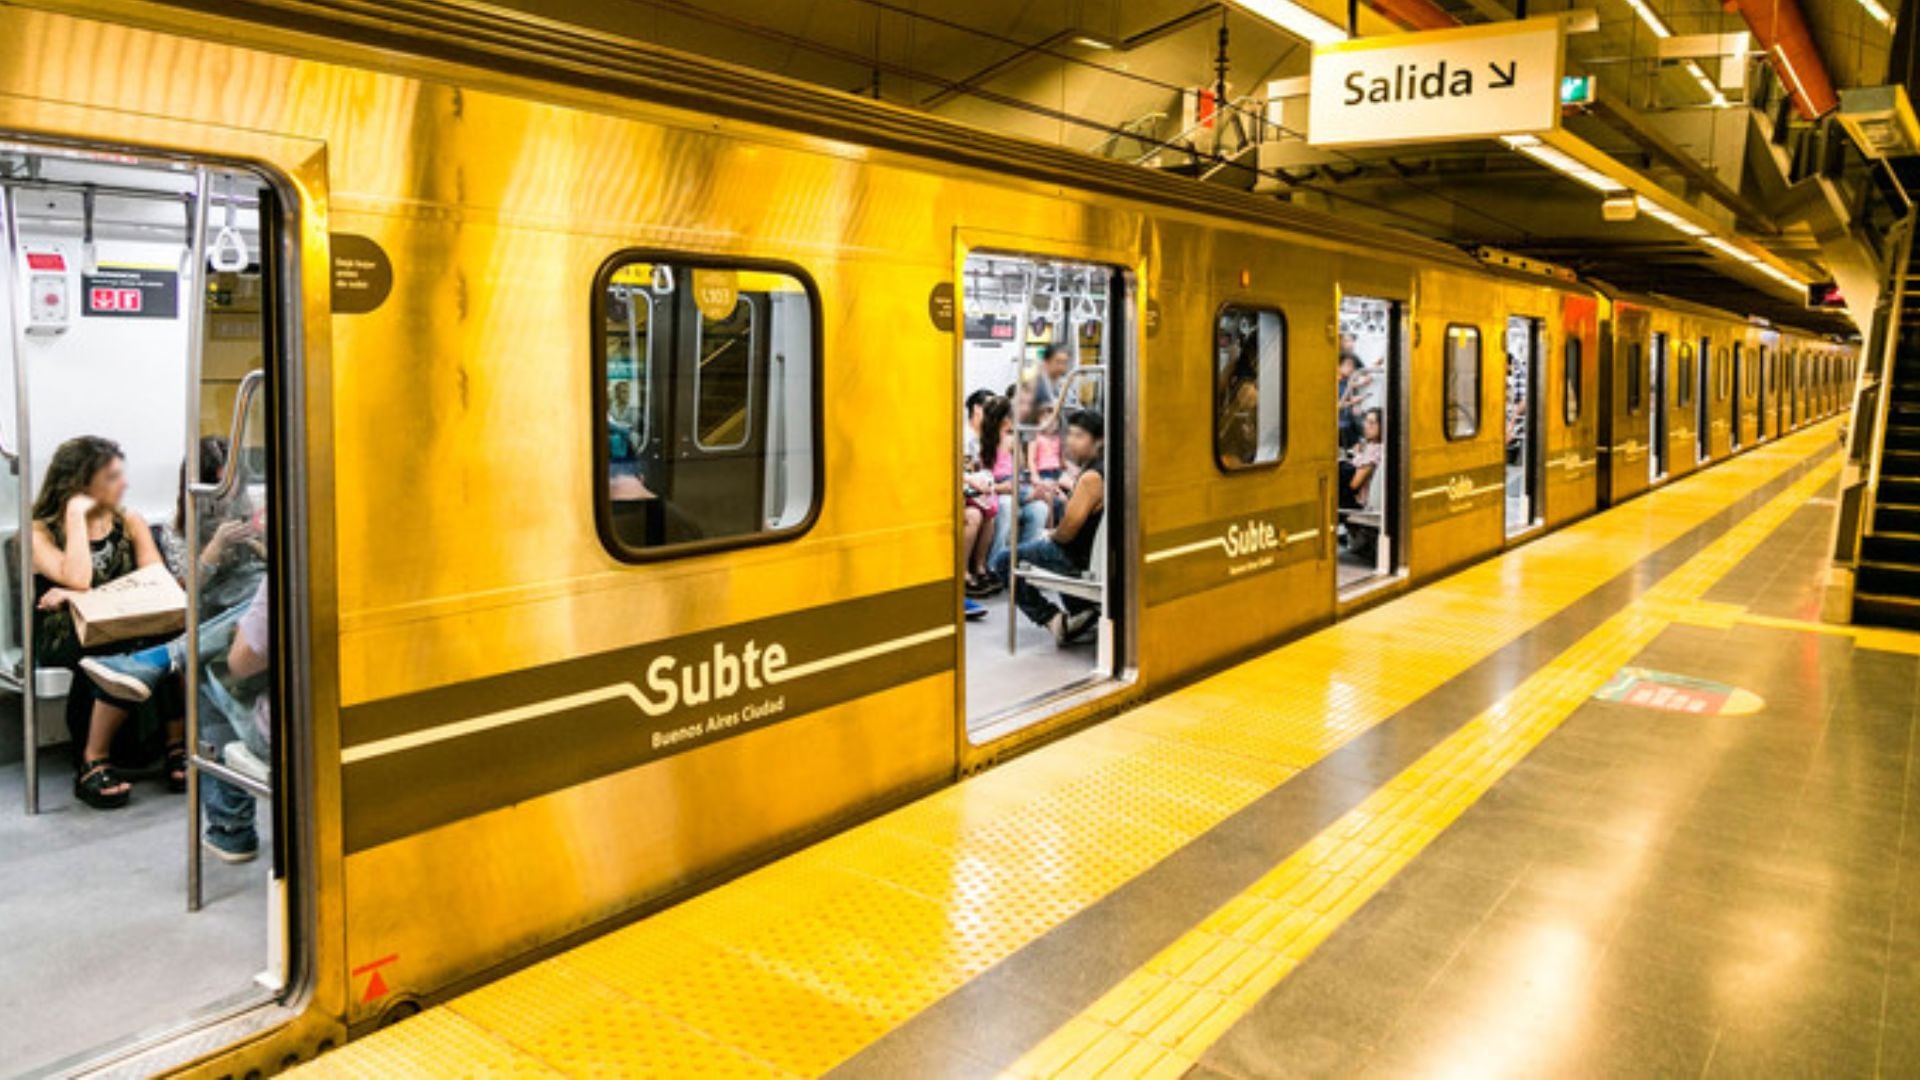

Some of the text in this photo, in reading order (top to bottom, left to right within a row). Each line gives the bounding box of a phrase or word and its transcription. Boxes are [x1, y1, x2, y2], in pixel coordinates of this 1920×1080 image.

[1344, 60, 1472, 106] Salida
[1227, 519, 1278, 558] Subte
[646, 639, 788, 716] Subte
[651, 695, 785, 750] Buenos Aires Ciudad
